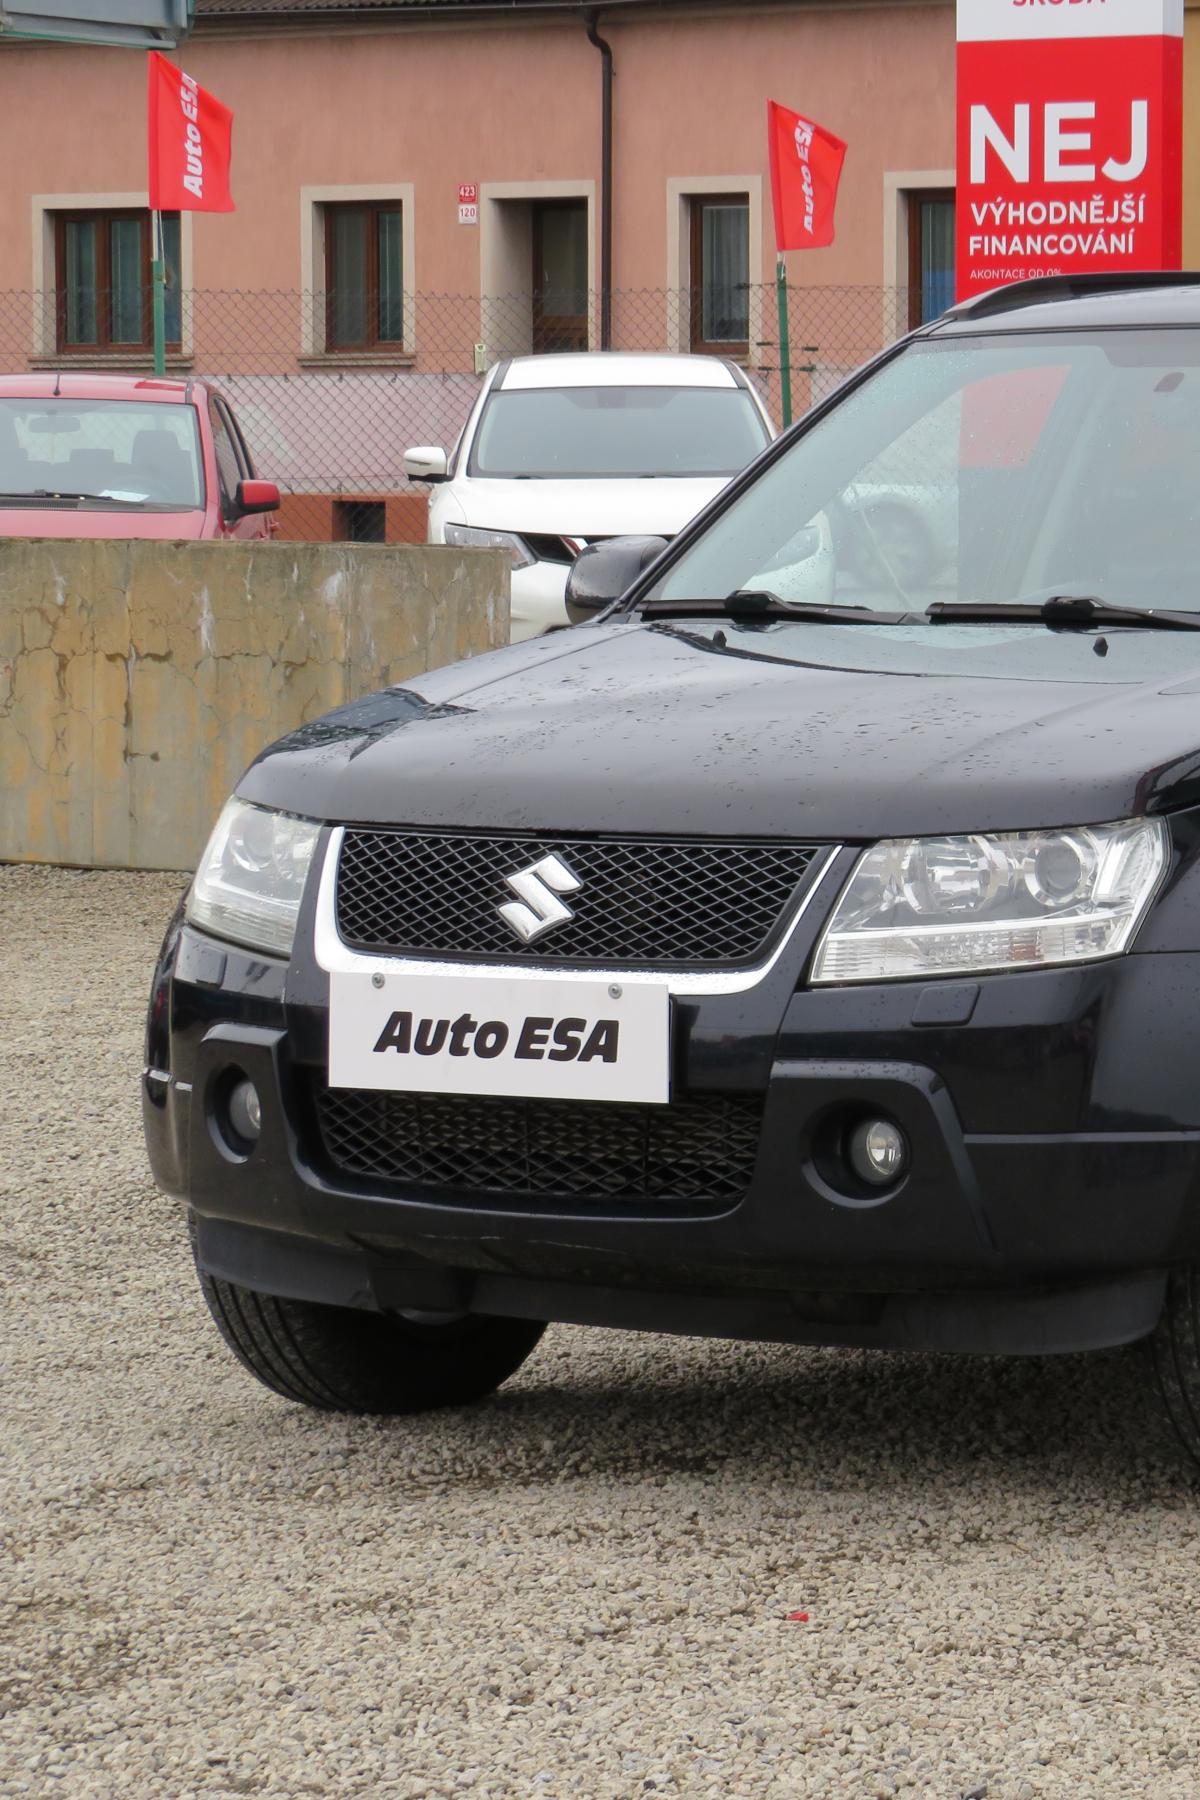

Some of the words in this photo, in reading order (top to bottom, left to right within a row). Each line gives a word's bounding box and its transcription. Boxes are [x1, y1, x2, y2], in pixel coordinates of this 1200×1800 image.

[970, 99, 1148, 184] NEJ
[183, 122, 203, 200] Auto
[460, 185, 475, 197] 423
[800, 164, 814, 235] Auto
[460, 207, 476, 217] 120
[970, 193, 1146, 226] VÝHODNĚJŠÍ
[969, 228, 1135, 256] FINANCOVÁNÍ
[969, 268, 1025, 280] AKONTACE
[1028, 268, 1044, 279] OD
[372, 1010, 509, 1059] Auto
[513, 1016, 620, 1063] ESA
